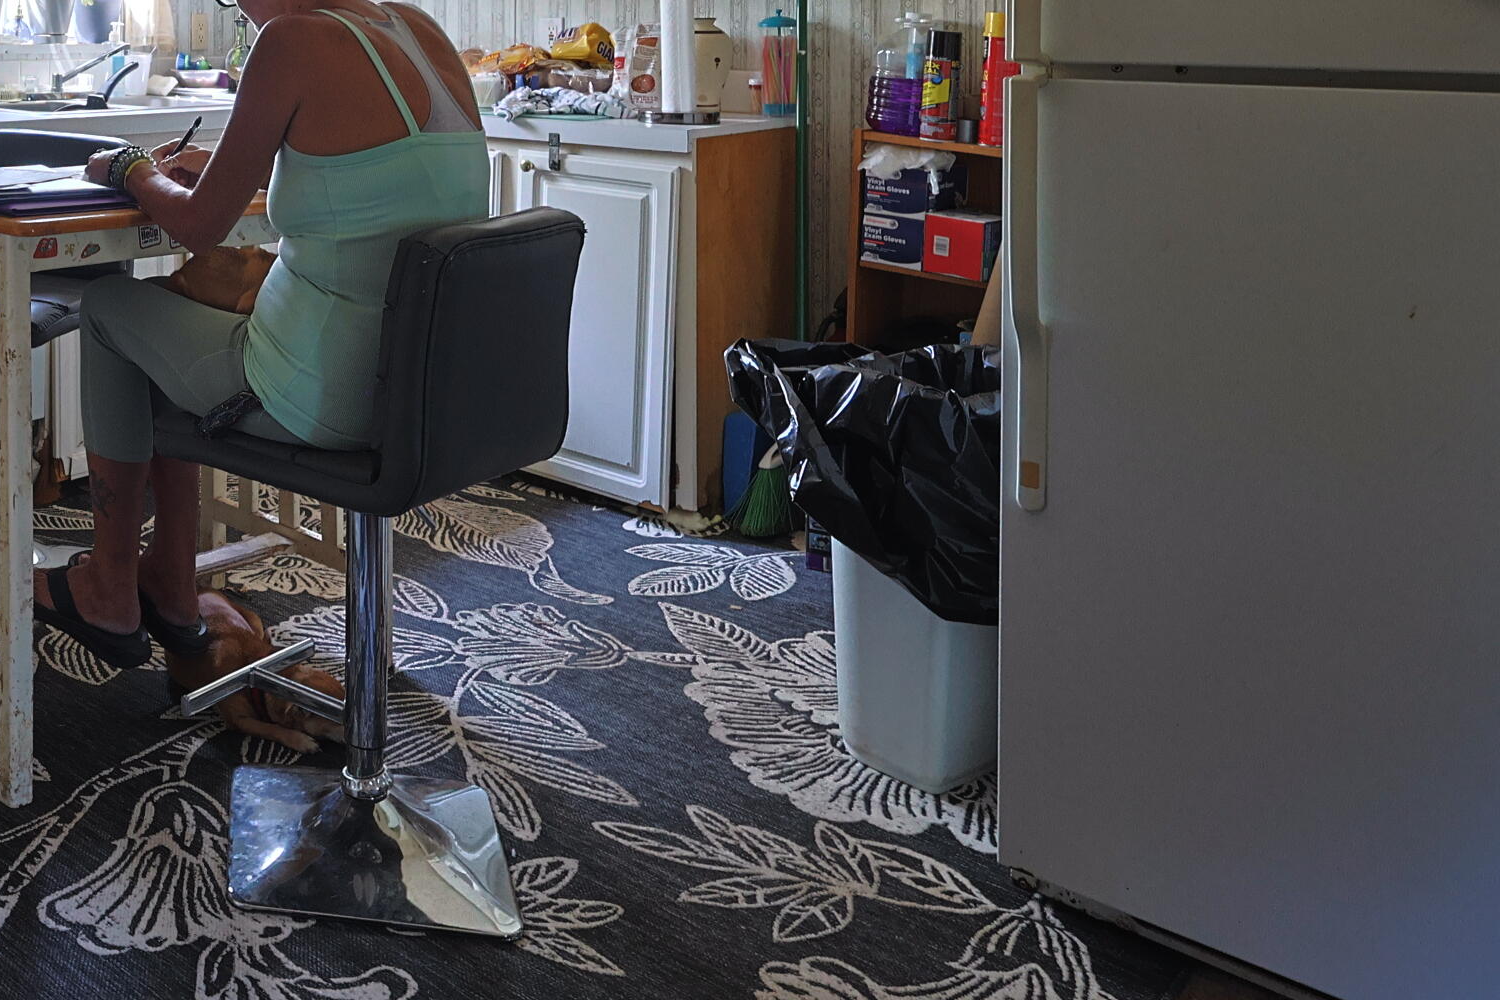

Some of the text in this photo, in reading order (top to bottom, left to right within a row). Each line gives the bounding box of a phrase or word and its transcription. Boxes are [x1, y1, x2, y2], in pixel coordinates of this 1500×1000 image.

[867, 177, 885, 187] Vinyl
[867, 183, 910, 195] Exam Gloves
[864, 226, 882, 236] Vinyl
[863, 232, 906, 245] Exam Gloves
